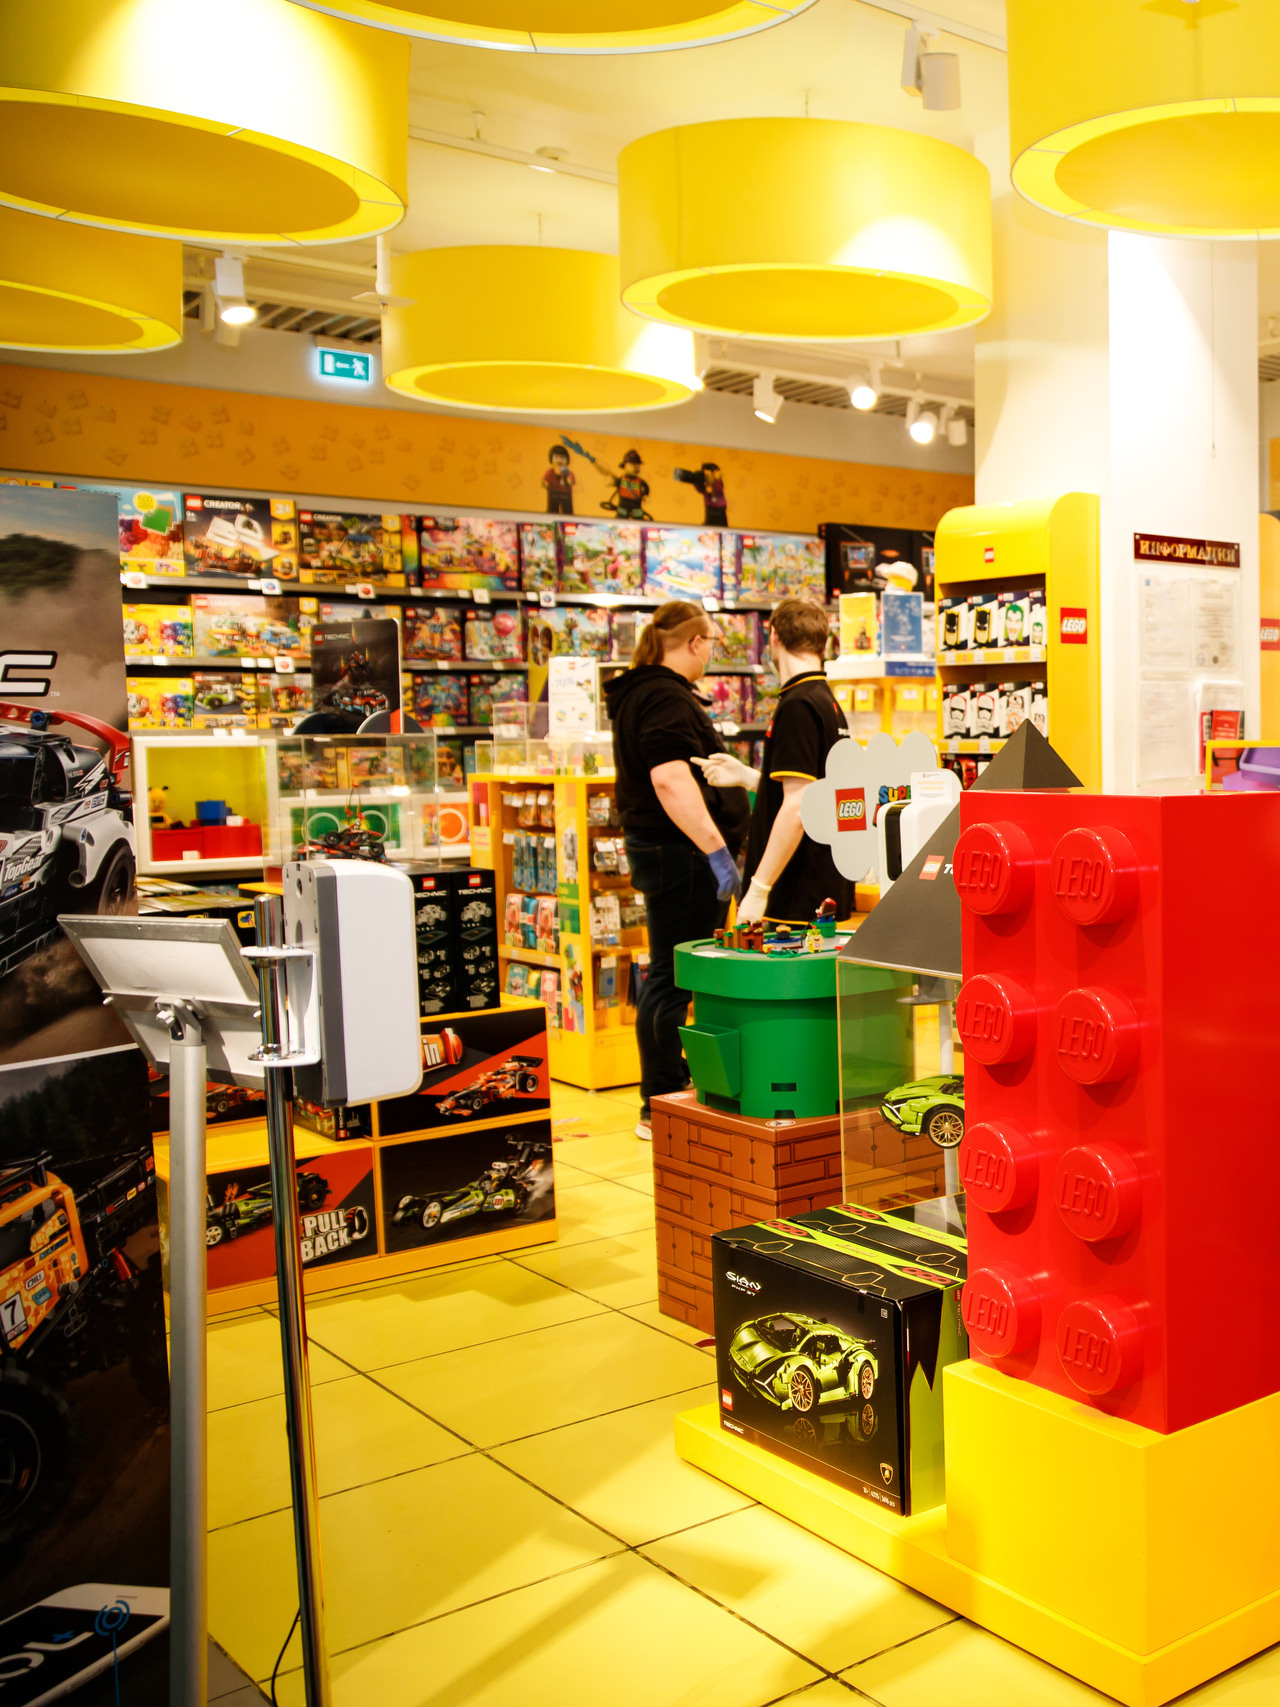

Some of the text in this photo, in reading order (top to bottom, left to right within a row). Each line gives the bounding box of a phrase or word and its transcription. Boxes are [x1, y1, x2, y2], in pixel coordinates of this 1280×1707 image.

[203, 499, 242, 511] CREATOR
[1062, 619, 1086, 633] LEGO
[1260, 629, 1279, 641] LEGO
[838, 800, 864, 819] LEGO
[878, 785, 912, 804] SUPE
[958, 850, 1003, 891] LEGO
[1055, 857, 1106, 901] LEGO
[457, 887, 494, 895] TECHNIC
[961, 1000, 1004, 1043] LEGO
[1058, 1015, 1106, 1062] LEGO
[963, 1146, 1008, 1193] LEGO
[1060, 1171, 1109, 1221] LEGO
[301, 1208, 348, 1239] PULL
[299, 1227, 351, 1263] BACK
[4, 1298, 17, 1328] 7
[965, 1290, 1008, 1339] LEGO
[1062, 1324, 1110, 1376] LEGO
